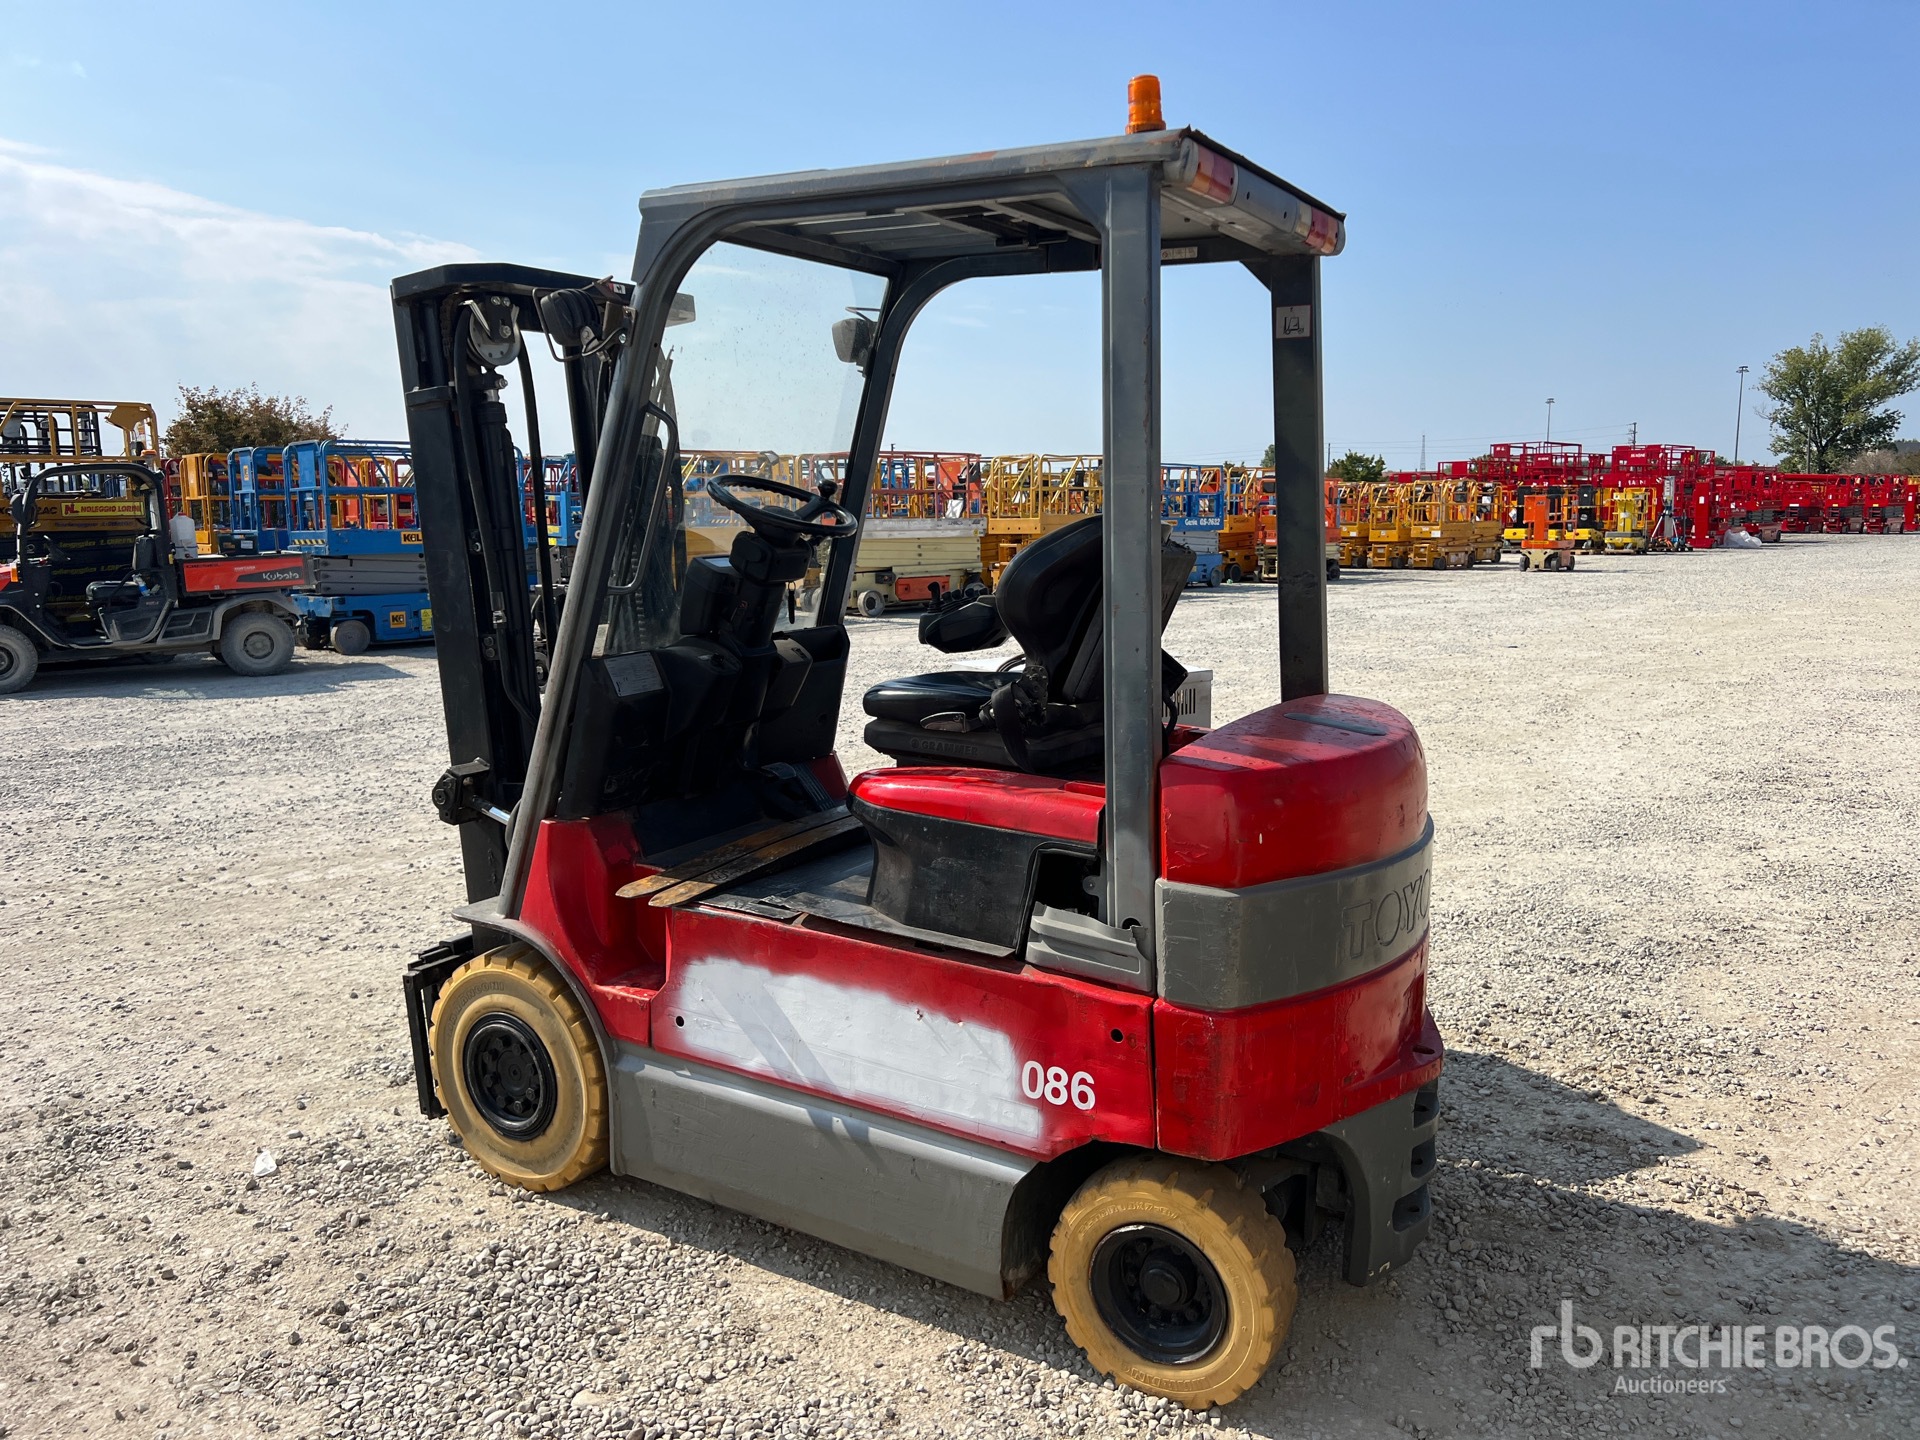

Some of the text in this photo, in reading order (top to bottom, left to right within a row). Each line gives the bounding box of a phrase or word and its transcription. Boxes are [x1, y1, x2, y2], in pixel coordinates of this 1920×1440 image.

[262, 571, 300, 581] Kubota
[921, 740, 979, 756] GRAMMER
[1021, 1060, 1096, 1111] 086
